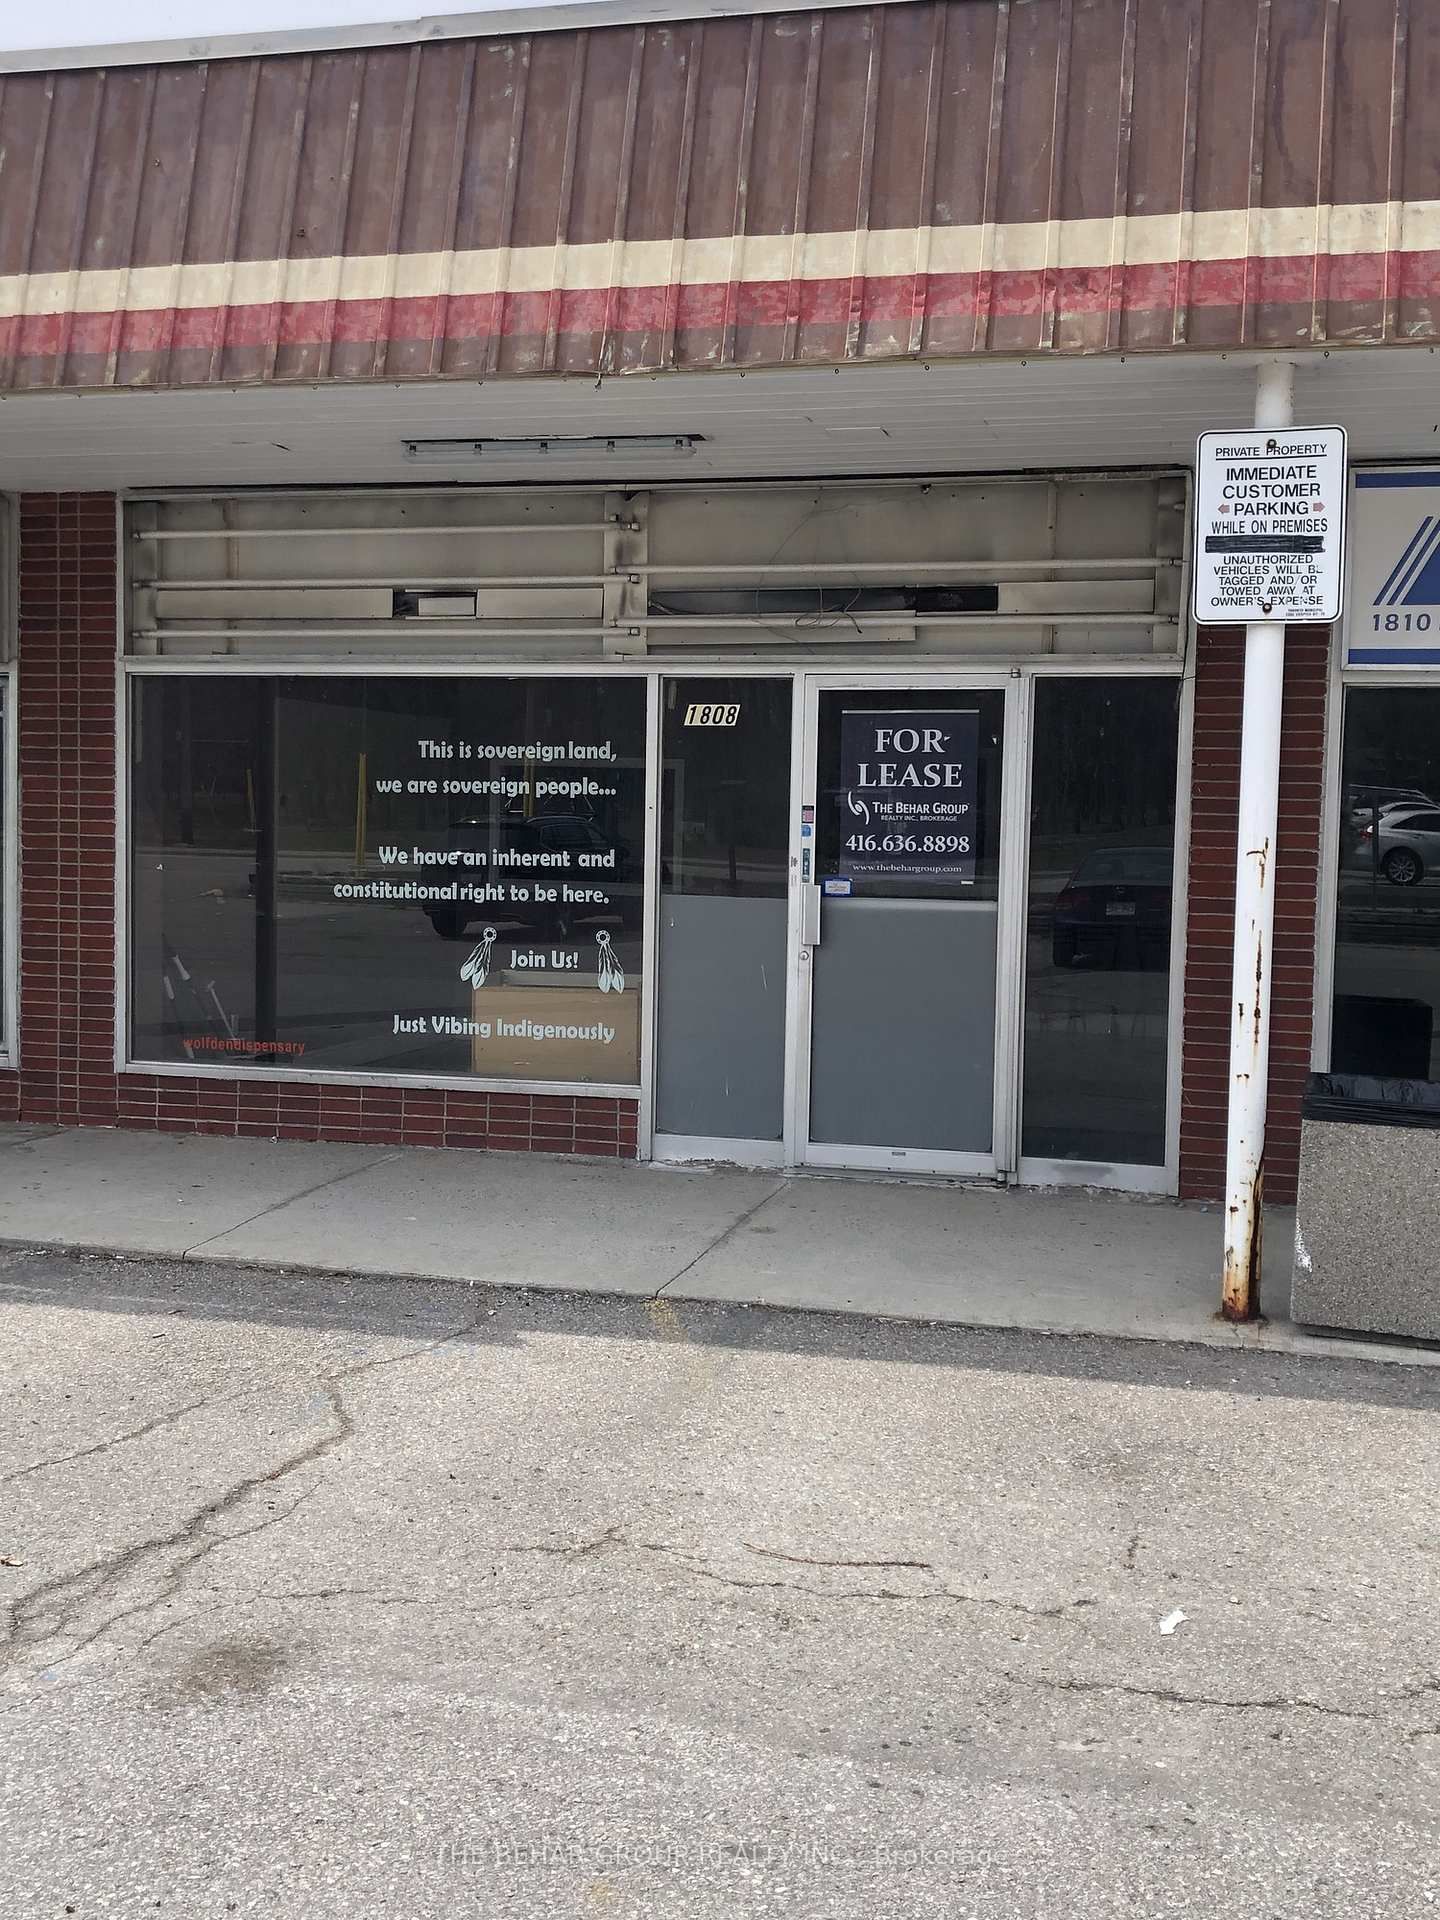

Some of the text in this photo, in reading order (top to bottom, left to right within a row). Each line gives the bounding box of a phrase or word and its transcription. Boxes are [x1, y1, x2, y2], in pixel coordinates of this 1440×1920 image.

[1215, 444, 1327, 457] PRIVATE PROPERTY
[1226, 465, 1317, 481] IMMEDIATE
[1222, 483, 1321, 499] CUSTOMER
[1234, 501, 1309, 516] PARKING
[1211, 518, 1328, 534] WHILE ON PREMISES
[1223, 554, 1313, 565] UNAUTHORIZED
[1213, 565, 1270, 575] VEHICLES
[1275, 565, 1303, 575] WILL
[1219, 575, 1265, 586] TAGGED
[1220, 585, 1316, 596] TOWED AWAY AT
[1210, 596, 1265, 607] OWNER'S
[1373, 613, 1432, 632] 1810
[688, 705, 738, 725] 1808
[874, 729, 945, 753] FOR
[418, 740, 617, 762] This is sovereign land,
[857, 763, 963, 788] LEASE
[376, 776, 617, 799] we are sovereign people...
[872, 801, 969, 815] THE BEHAR GROUP
[845, 834, 970, 853] 416.636.8898
[378, 846, 616, 868] We have an inherent and
[852, 864, 962, 874] www.thebehargroup.com
[333, 882, 610, 904] constitutional right to be here.
[510, 949, 579, 969] Join Us!
[392, 1014, 616, 1044] Just Vibing Indigenously
[183, 1036, 305, 1056] wolfdendispensary
